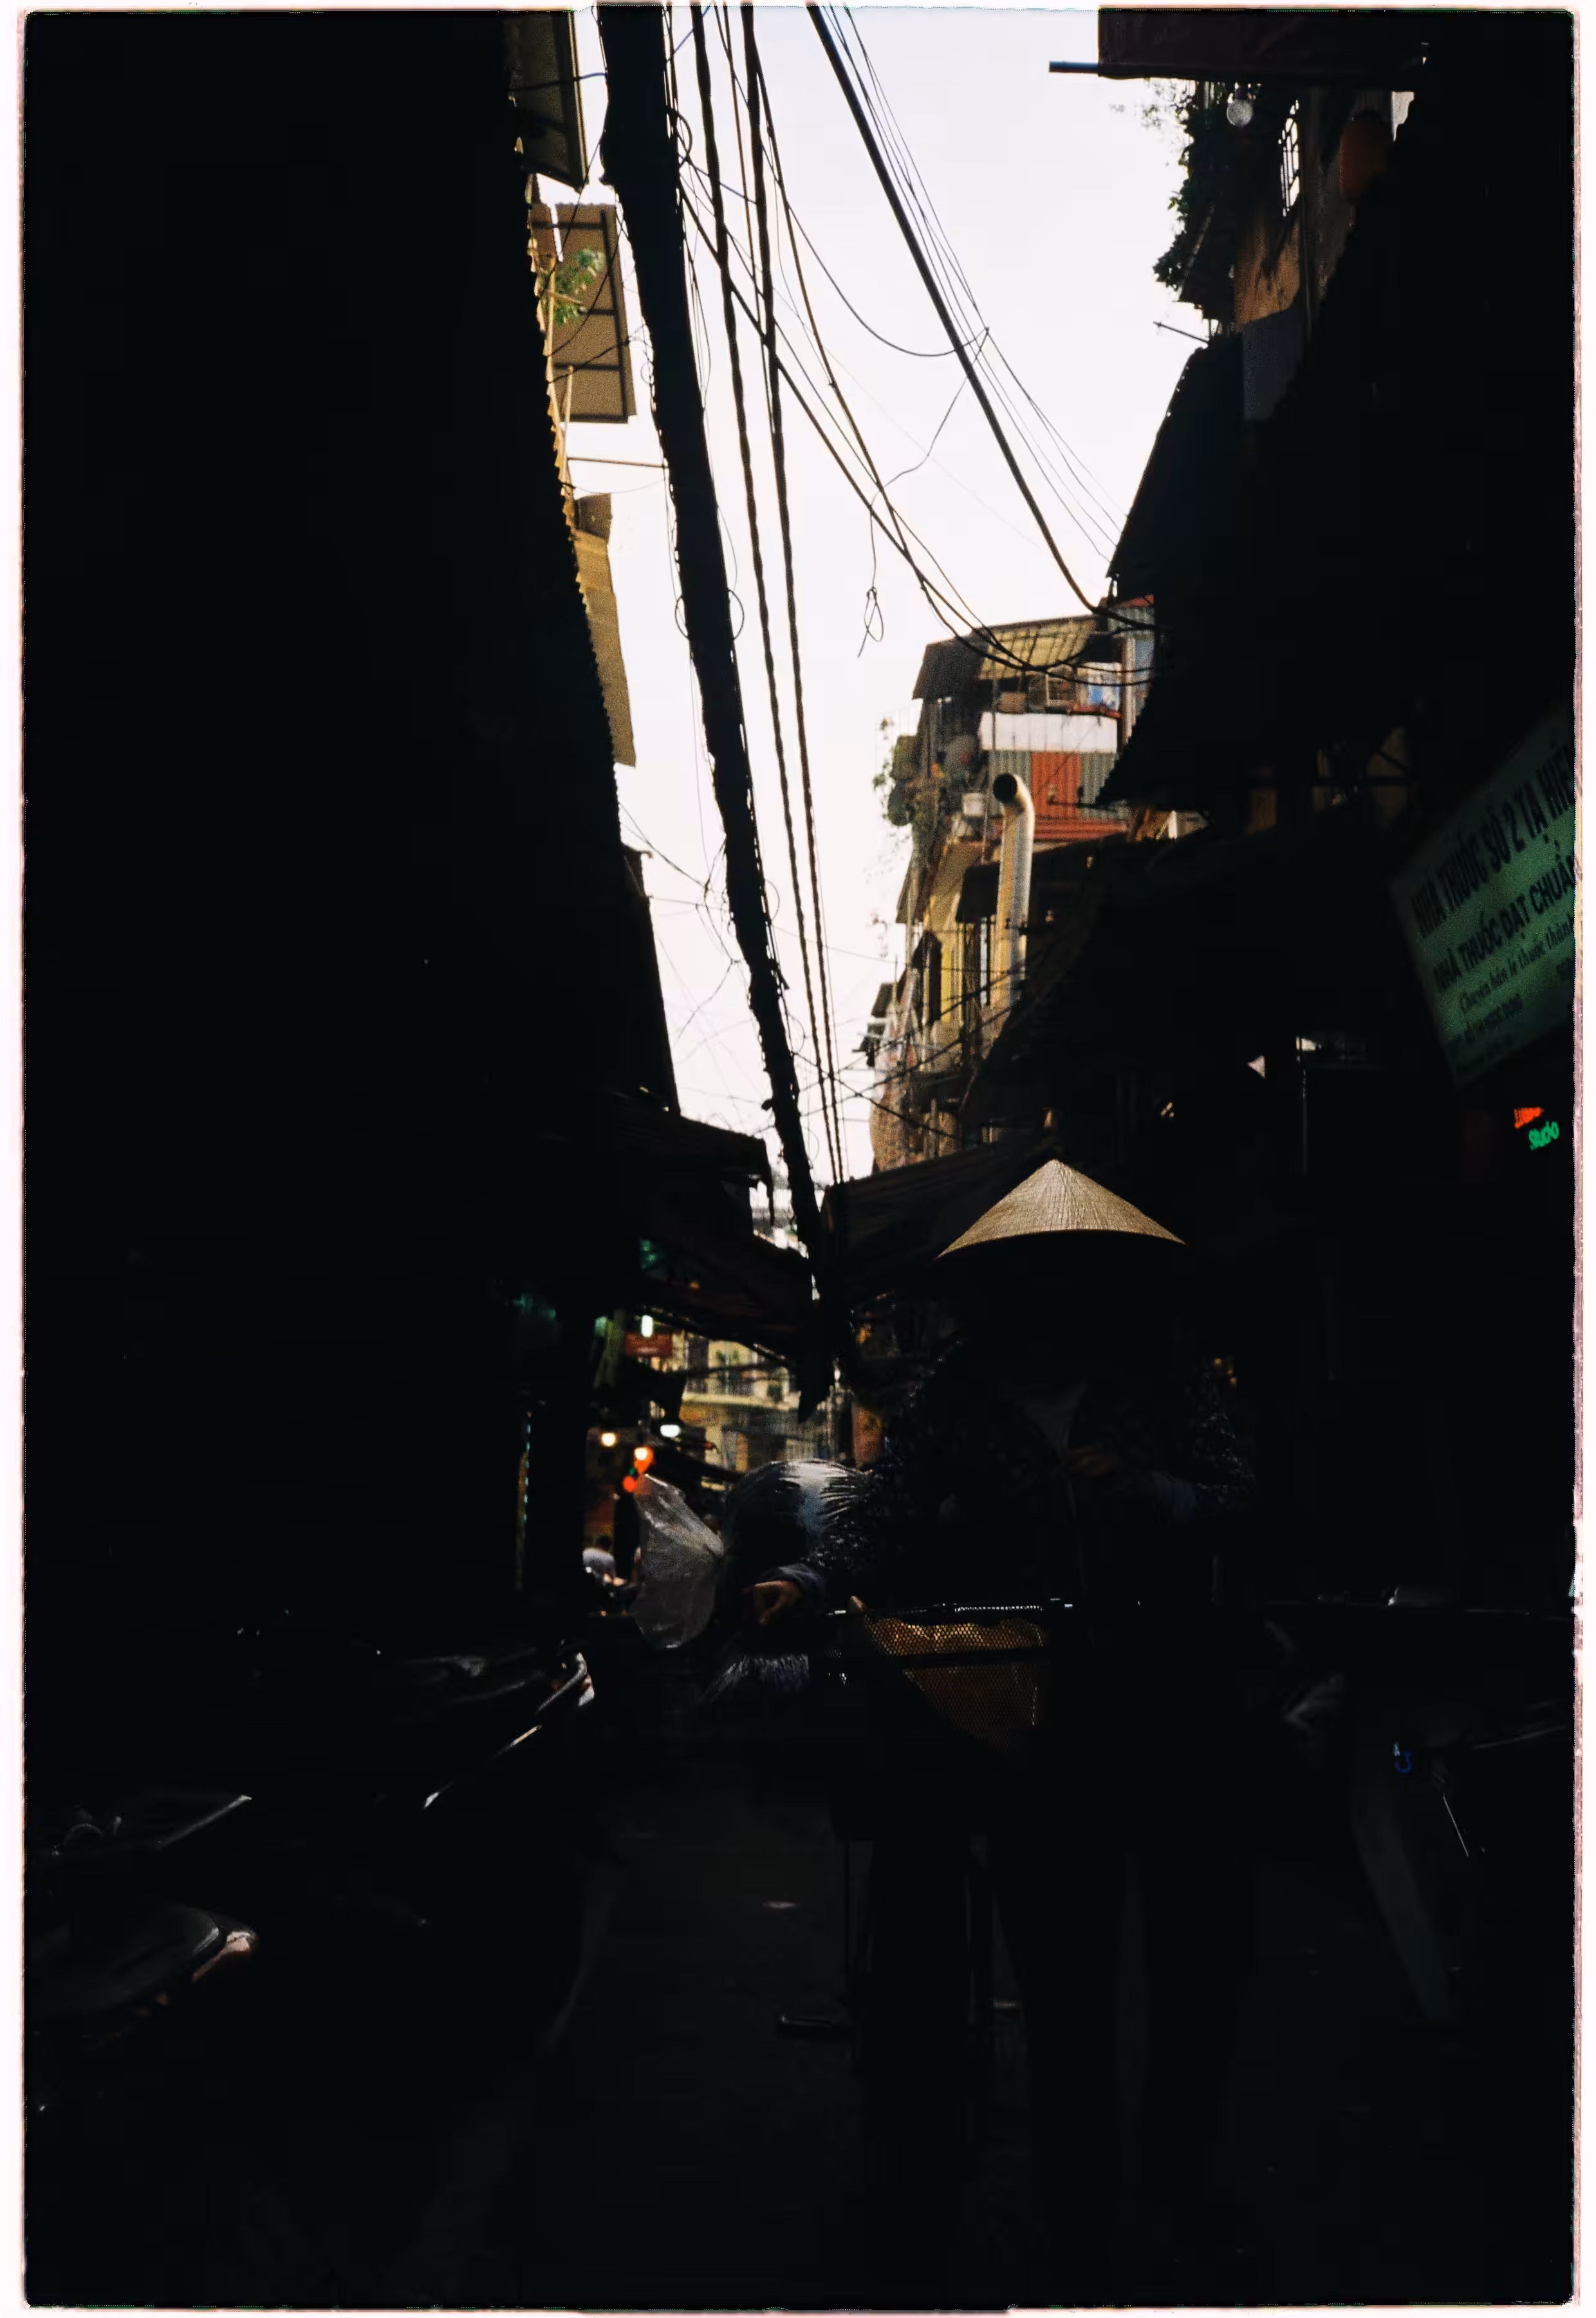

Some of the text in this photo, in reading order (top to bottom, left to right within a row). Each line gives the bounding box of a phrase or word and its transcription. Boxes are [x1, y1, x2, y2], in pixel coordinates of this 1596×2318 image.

[1503, 798, 1525, 854] 2
[1514, 775, 1548, 842] TẠ
[1457, 911, 1503, 971] THUỐC
[1498, 893, 1531, 940] ĐẠT
[1528, 841, 1573, 915] CHUẨ
